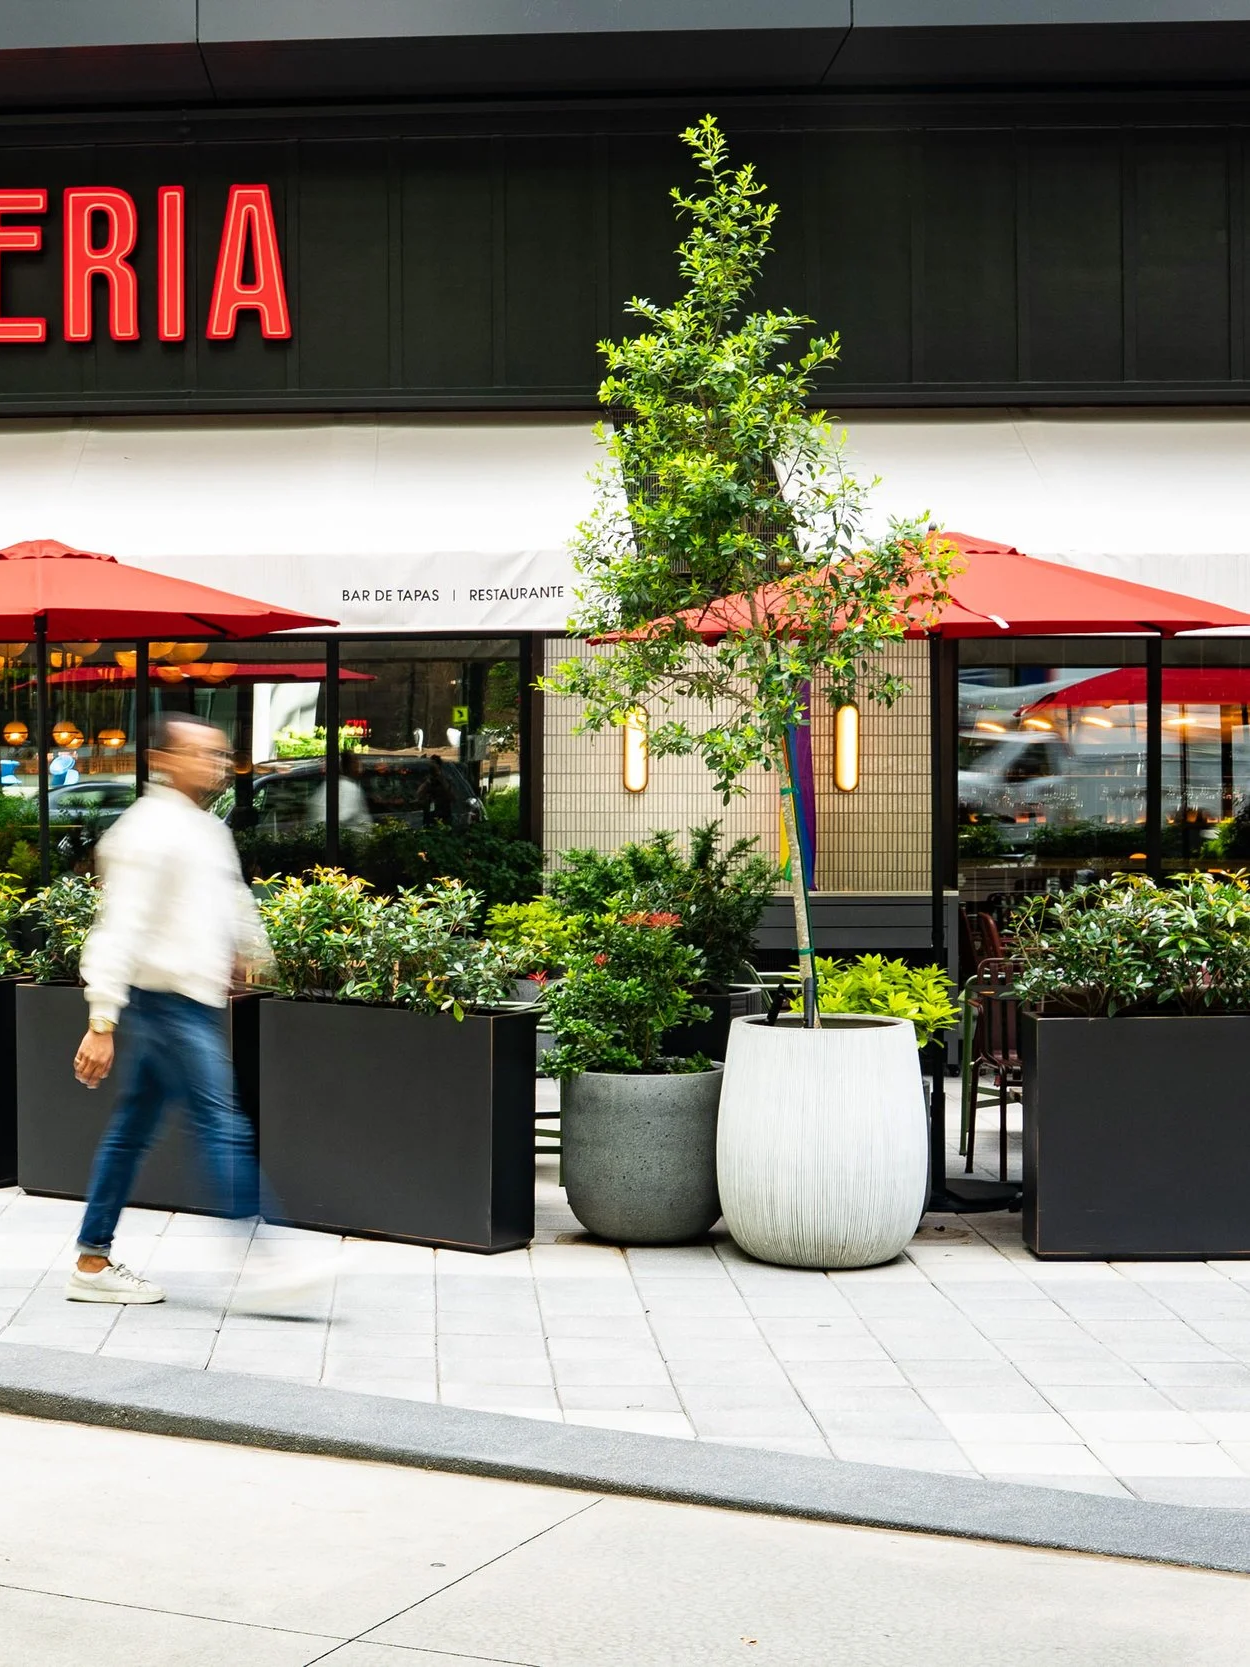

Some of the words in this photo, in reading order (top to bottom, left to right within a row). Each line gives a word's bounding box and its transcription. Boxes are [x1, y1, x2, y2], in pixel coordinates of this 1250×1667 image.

[342, 589, 371, 602] BAR
[374, 589, 393, 602] DE
[396, 589, 440, 602] TAPAS
[469, 585, 564, 602] RESTAURANTE
